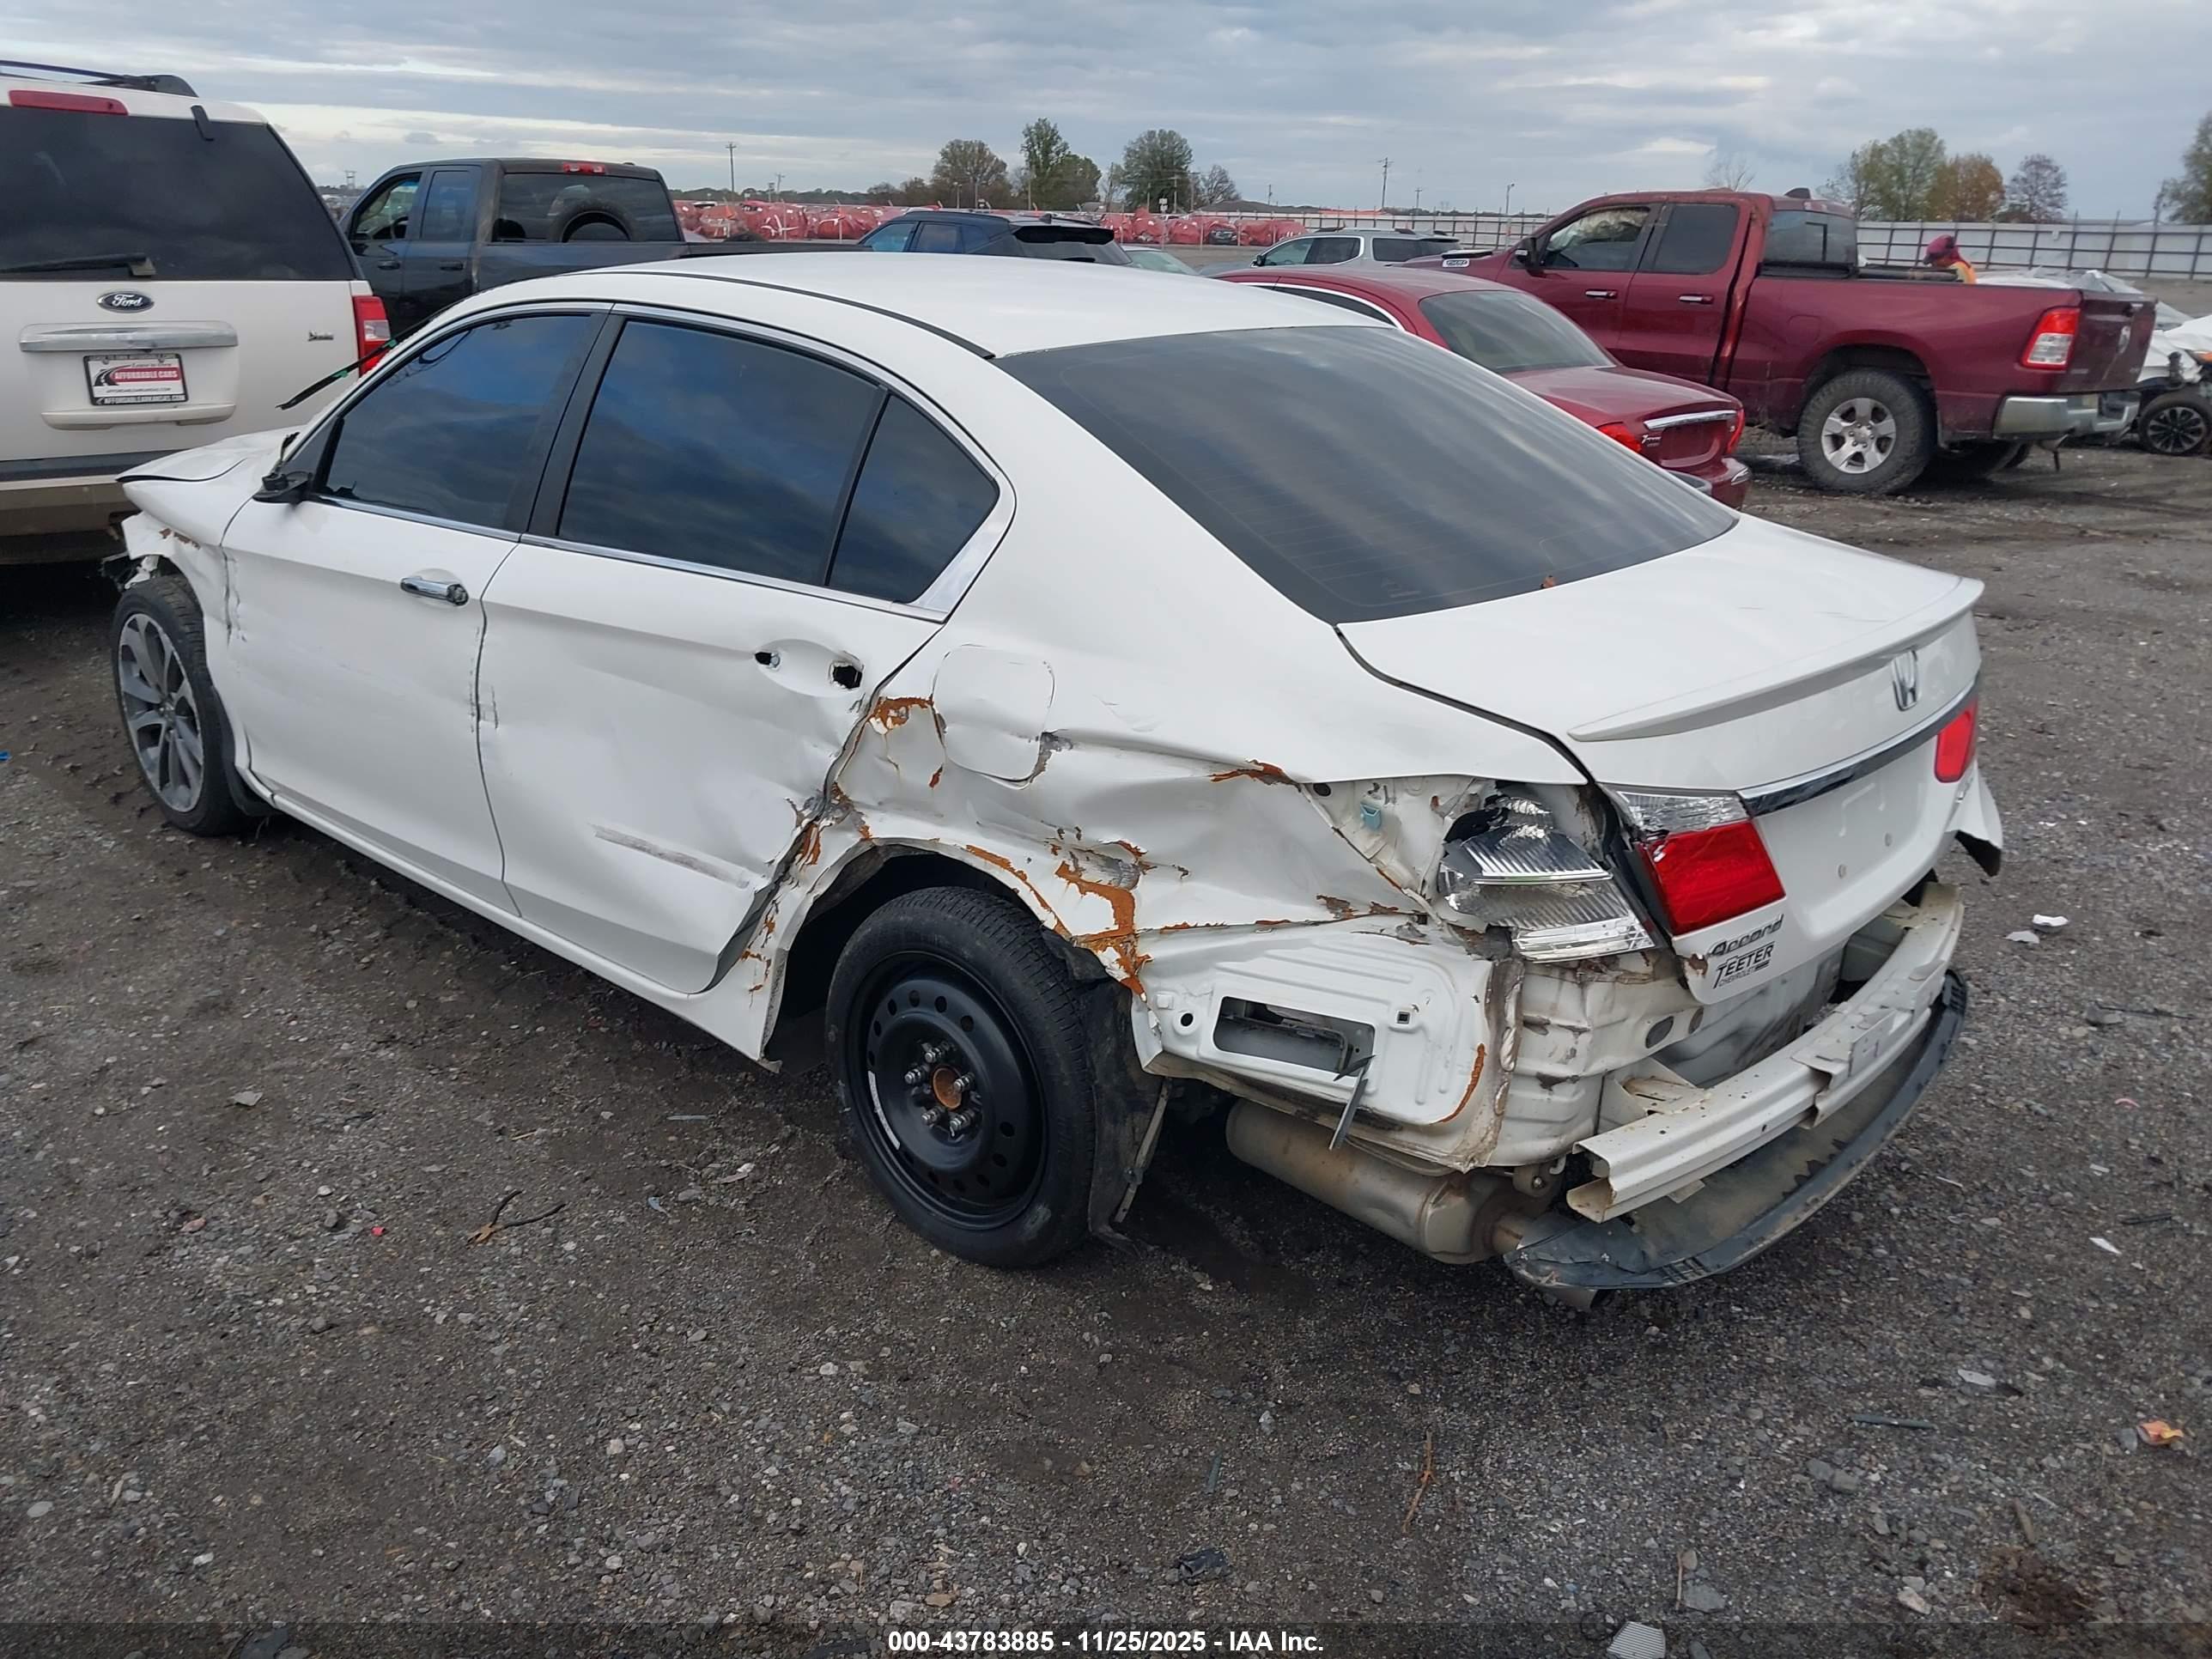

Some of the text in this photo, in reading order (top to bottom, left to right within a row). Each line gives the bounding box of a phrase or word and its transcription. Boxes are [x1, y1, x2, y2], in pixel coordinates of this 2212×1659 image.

[112, 294, 143, 307] Ford
[1707, 913, 1784, 957] Accord
[1713, 944, 1775, 989] TEETER
